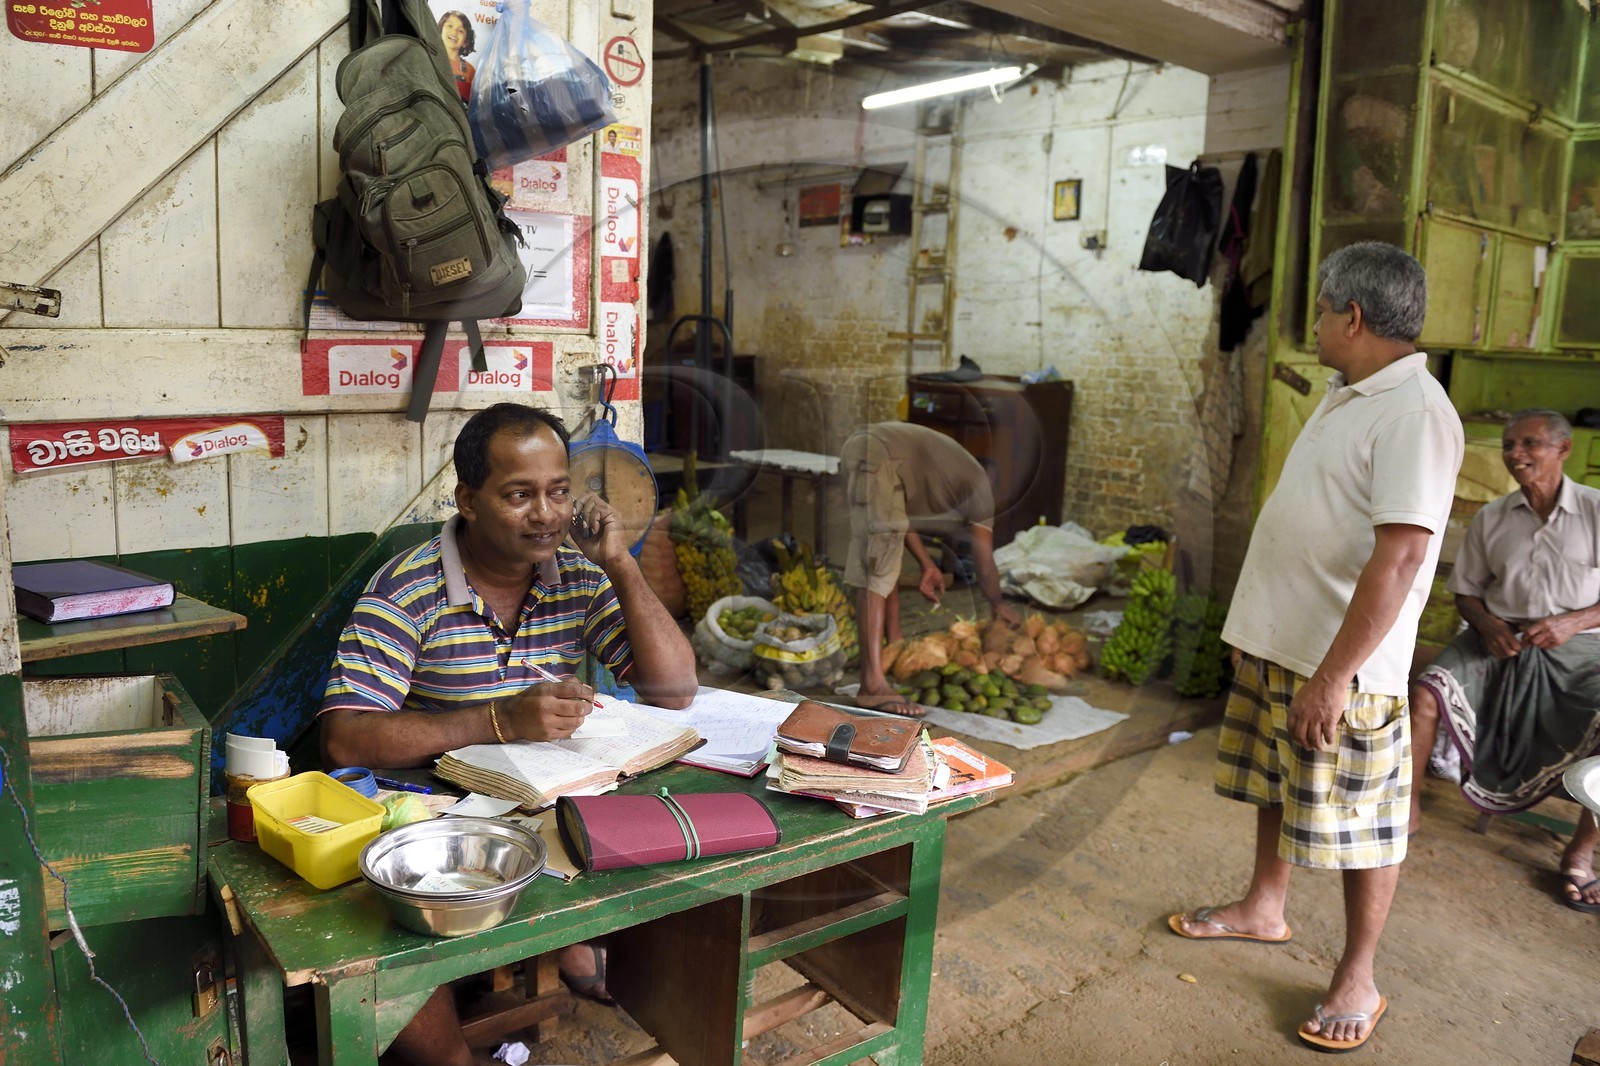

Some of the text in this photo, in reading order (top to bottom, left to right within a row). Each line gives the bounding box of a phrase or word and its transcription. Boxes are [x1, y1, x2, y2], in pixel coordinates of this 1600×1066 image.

[520, 177, 557, 192] Dialog
[605, 187, 619, 245] Dialog
[525, 224, 538, 234] TV
[435, 260, 469, 281] DIESEL
[339, 369, 401, 389] Dialog
[467, 370, 521, 388] Dialog
[203, 431, 248, 453] Dialog
